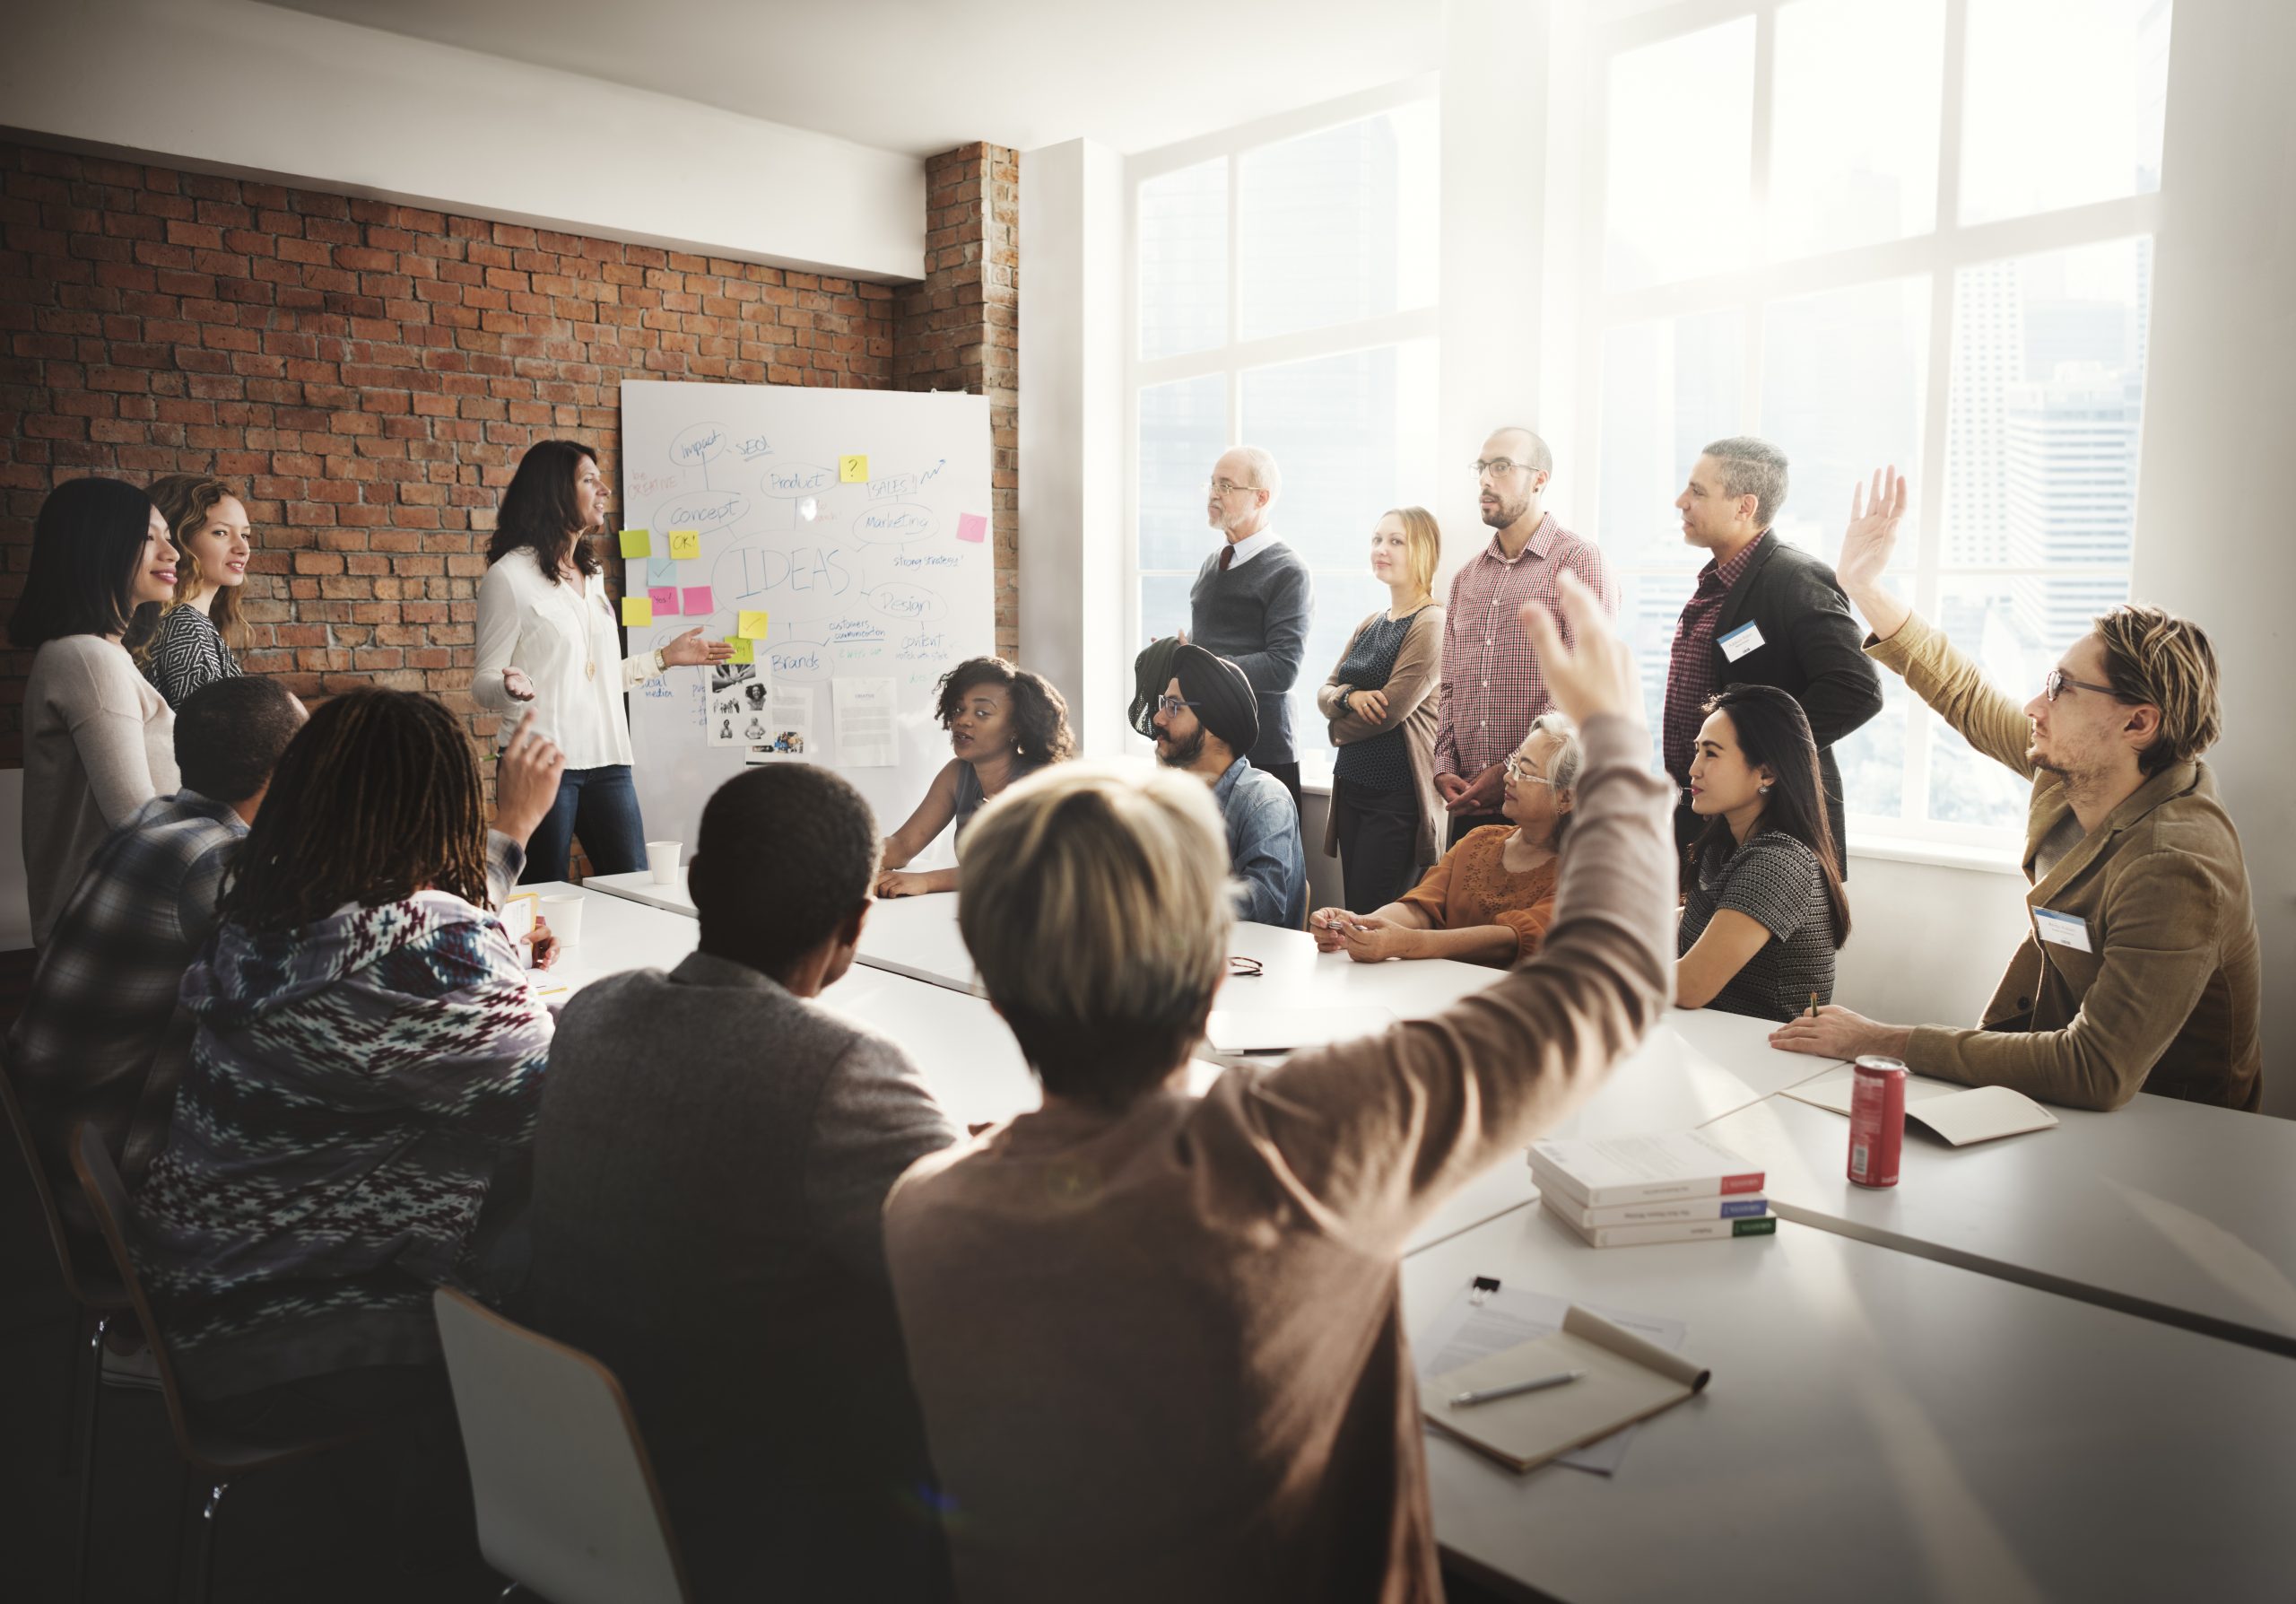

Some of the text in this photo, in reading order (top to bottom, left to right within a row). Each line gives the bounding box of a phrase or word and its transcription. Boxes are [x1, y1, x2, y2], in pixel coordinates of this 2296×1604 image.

[680, 429, 721, 459] Impact
[848, 458, 858, 477] ?
[770, 473, 825, 490] Product
[673, 534, 695, 551] OK!
[729, 546, 850, 600] IDEAS
[881, 592, 931, 618] Design
[771, 651, 820, 672] Brands
